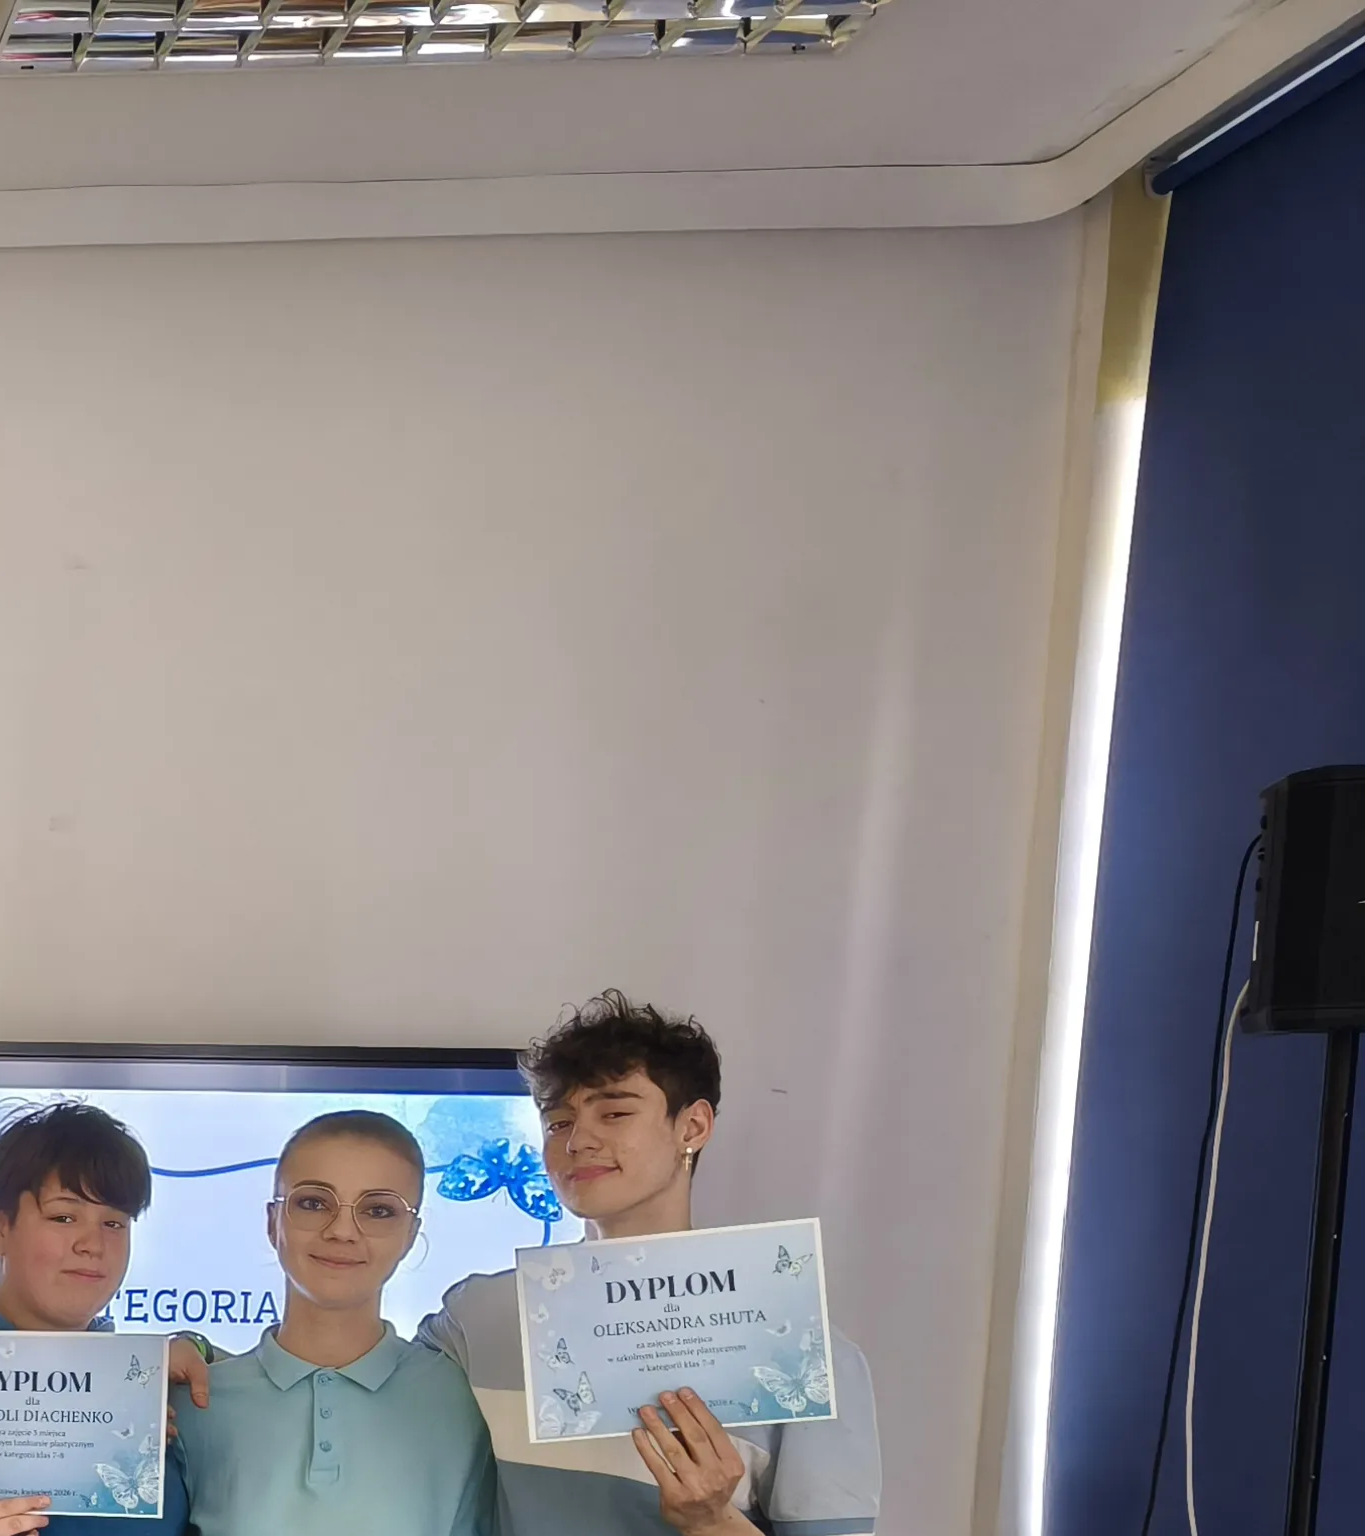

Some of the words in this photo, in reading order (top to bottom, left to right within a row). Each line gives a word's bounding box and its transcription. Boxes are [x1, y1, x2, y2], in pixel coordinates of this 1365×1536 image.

[605, 1269, 737, 1304] DYPLOM
[663, 1303, 681, 1313] dla
[593, 1315, 706, 1338] OLEKSANDRA
[709, 1309, 768, 1327] SHUTA
[25, 1397, 40, 1406] dla
[23, 1410, 114, 1424] DIACHENKO
